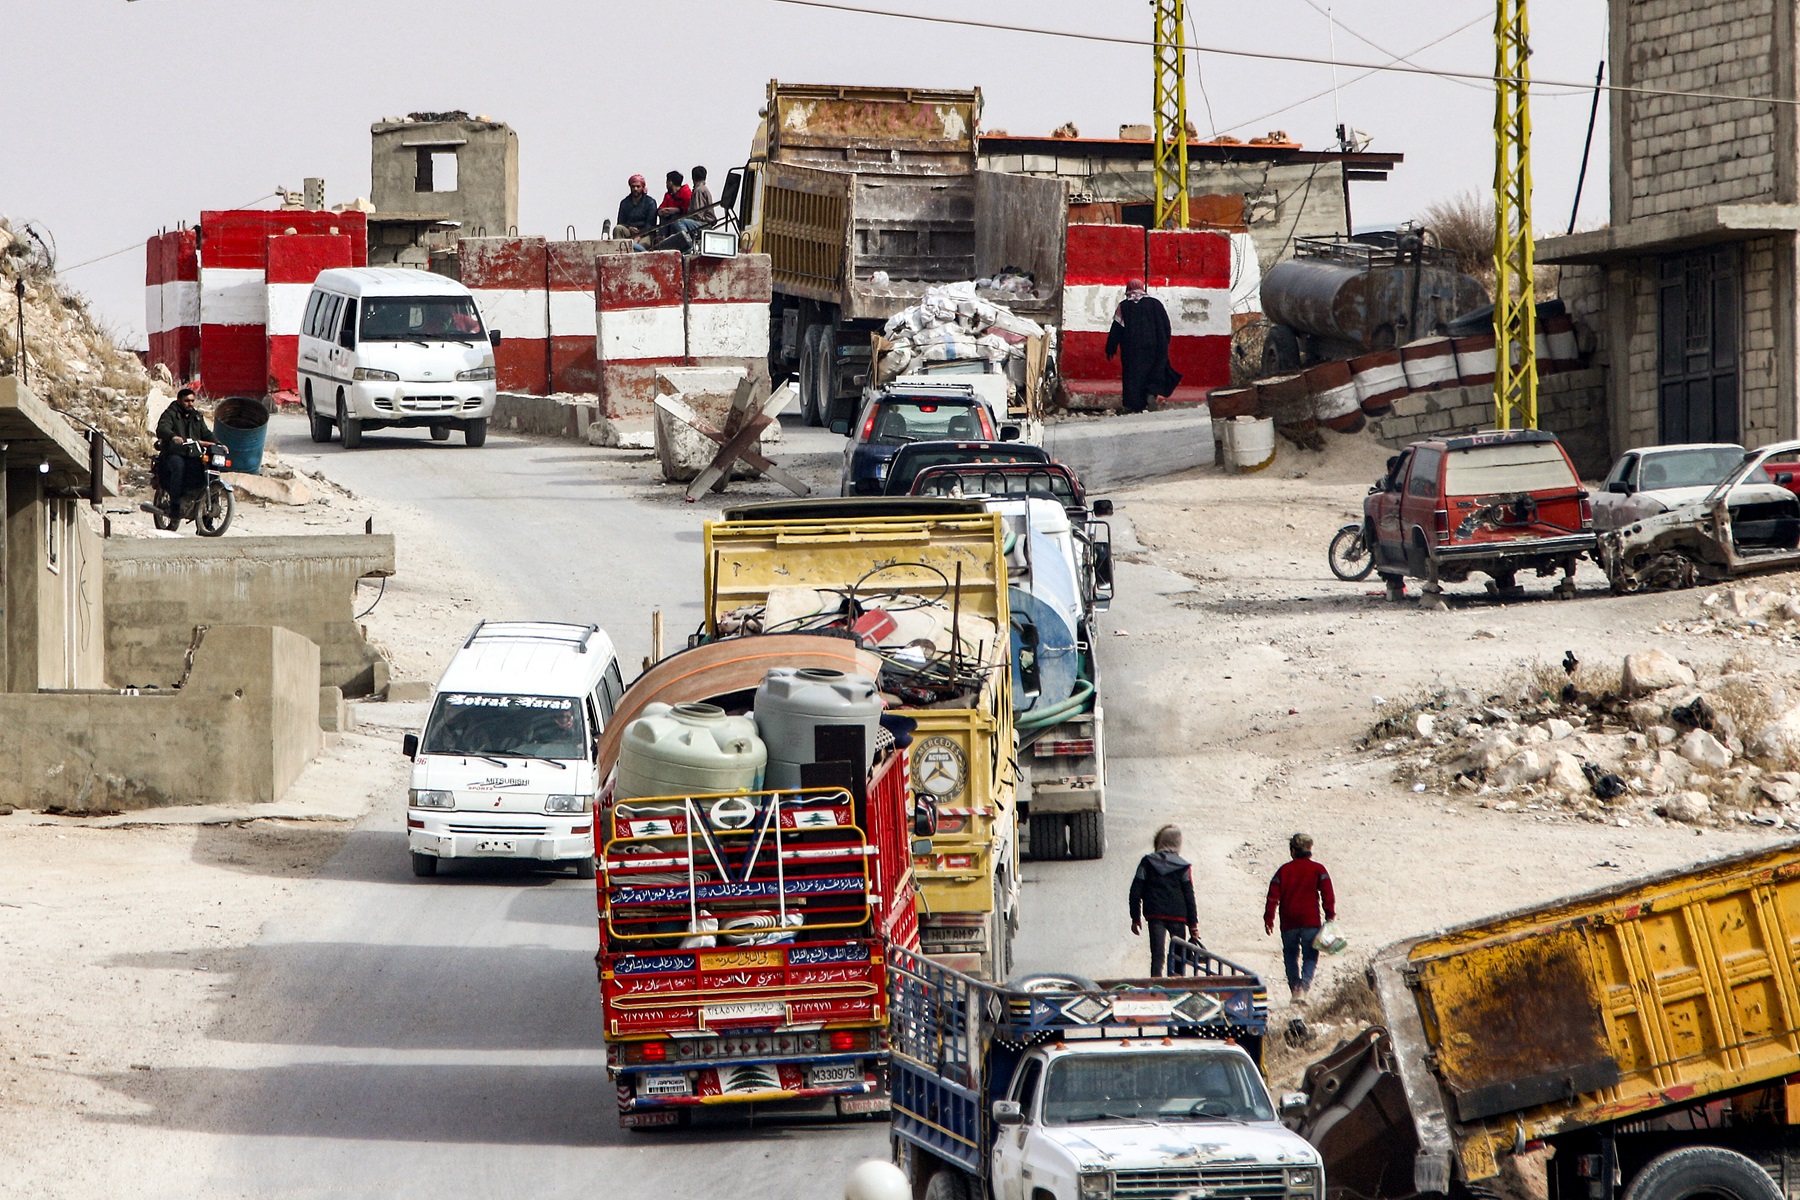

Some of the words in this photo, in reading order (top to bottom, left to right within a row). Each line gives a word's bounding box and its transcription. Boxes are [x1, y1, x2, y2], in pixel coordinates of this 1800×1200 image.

[918, 738, 960, 755] MERCEDES
[486, 777, 530, 786] MITSUBISHI
[814, 1067, 855, 1081] M330975
[638, 1112, 676, 1124] HINO
